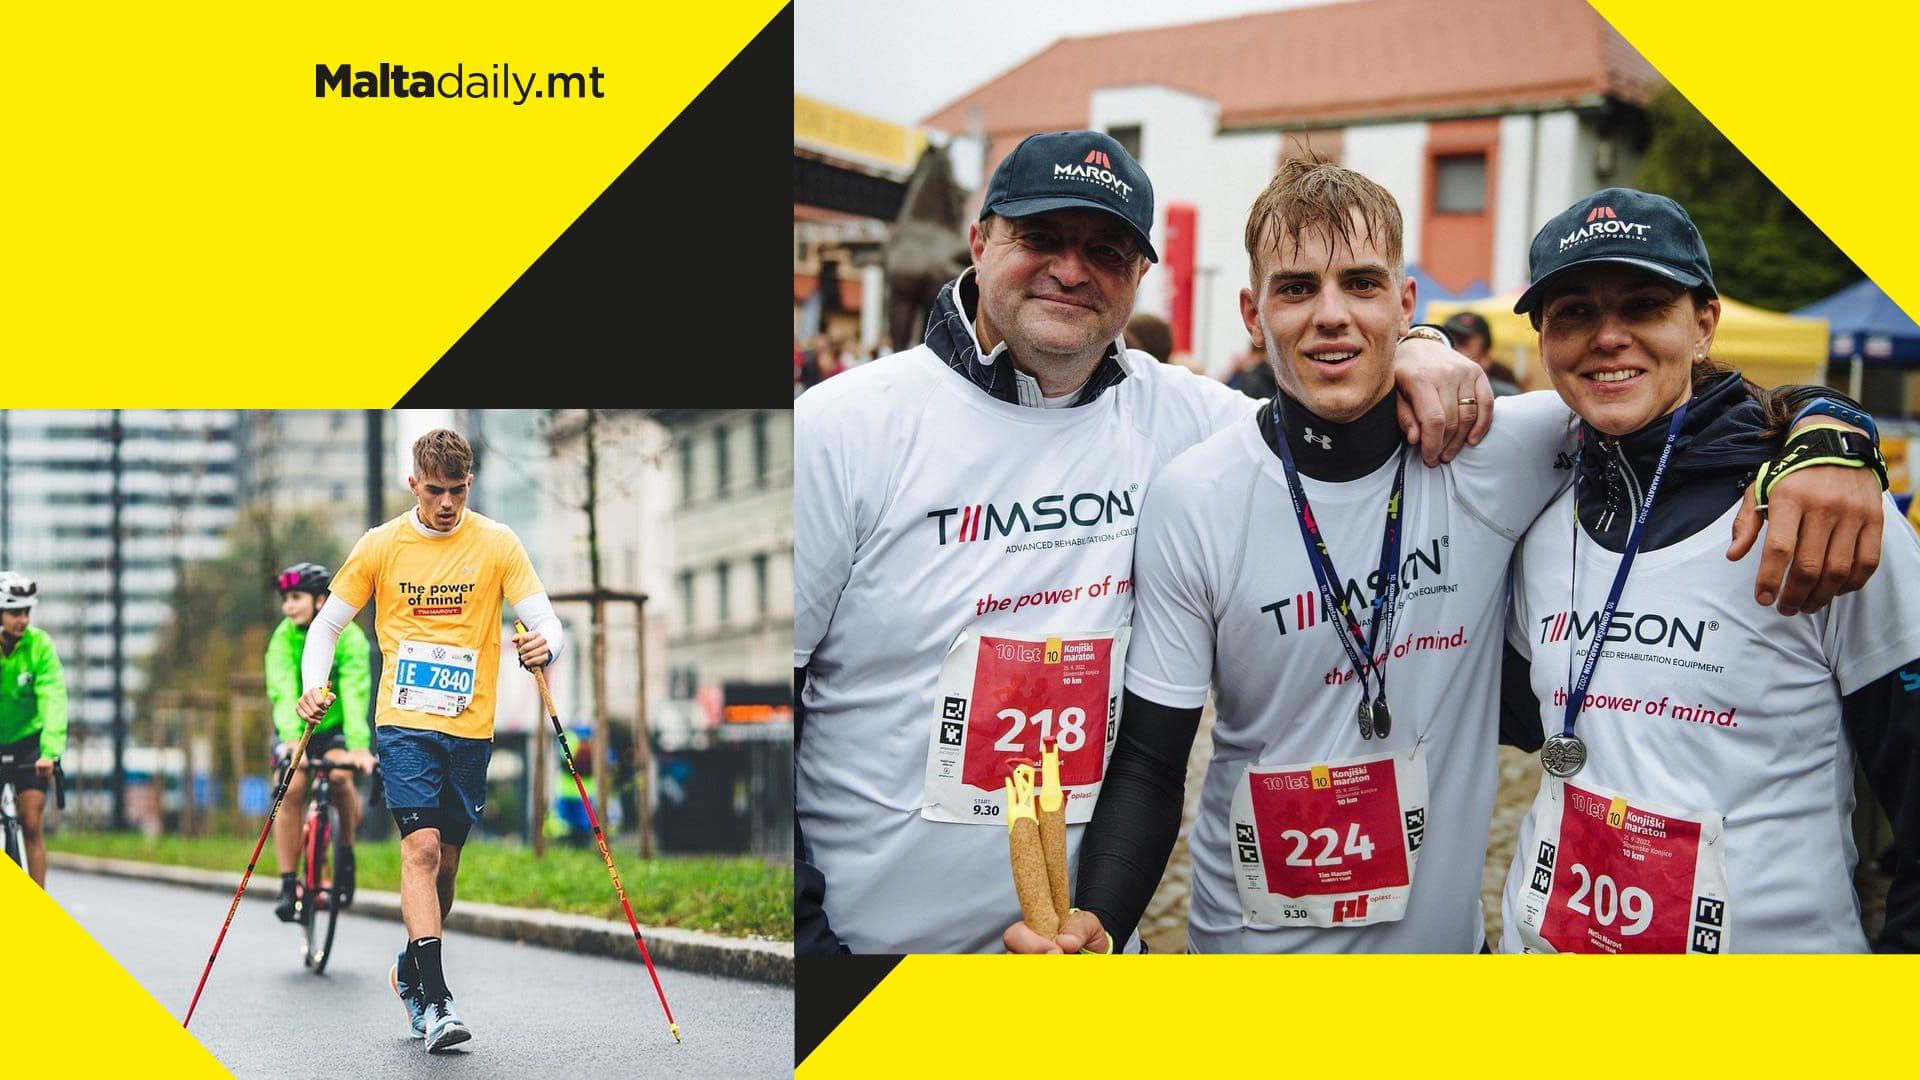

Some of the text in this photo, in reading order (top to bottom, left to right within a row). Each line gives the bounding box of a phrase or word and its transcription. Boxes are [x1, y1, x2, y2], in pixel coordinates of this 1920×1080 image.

[1054, 163, 1132, 196] MAROVT
[1560, 220, 1650, 250] MAROVT
[1642, 474, 1661, 508] MARATON
[1637, 507, 1648, 524] 2022
[1005, 541, 1053, 554] ADVANCED
[400, 583, 475, 596] The power
[976, 593, 1012, 617] the
[1013, 586, 1082, 613] power
[1088, 575, 1111, 597] of
[408, 594, 467, 606] of mind.
[996, 644, 1041, 662] 10 let
[1063, 653, 1095, 662] maraton
[1324, 666, 1354, 685] the
[1417, 626, 1467, 651] mind.
[1576, 649, 1724, 674] ADCED REHABILITATION EQUIPMENT
[1582, 641, 1600, 674] MARATON
[429, 666, 470, 692] 7840
[1576, 674, 1588, 691] 2022
[1554, 687, 1738, 727] th power of mind.
[994, 707, 1087, 753] 218
[1264, 776, 1310, 790] 10 let
[1333, 775, 1370, 786] maraton
[973, 805, 1000, 816] 9.30
[1572, 793, 1605, 820] 10 let
[1626, 811, 1665, 829] Konjiški
[1624, 822, 1666, 838] maraton
[1281, 823, 1375, 867] 224
[1623, 849, 1645, 861] 10 km
[1567, 863, 1654, 936] 209
[1283, 909, 1307, 919] 9.30
